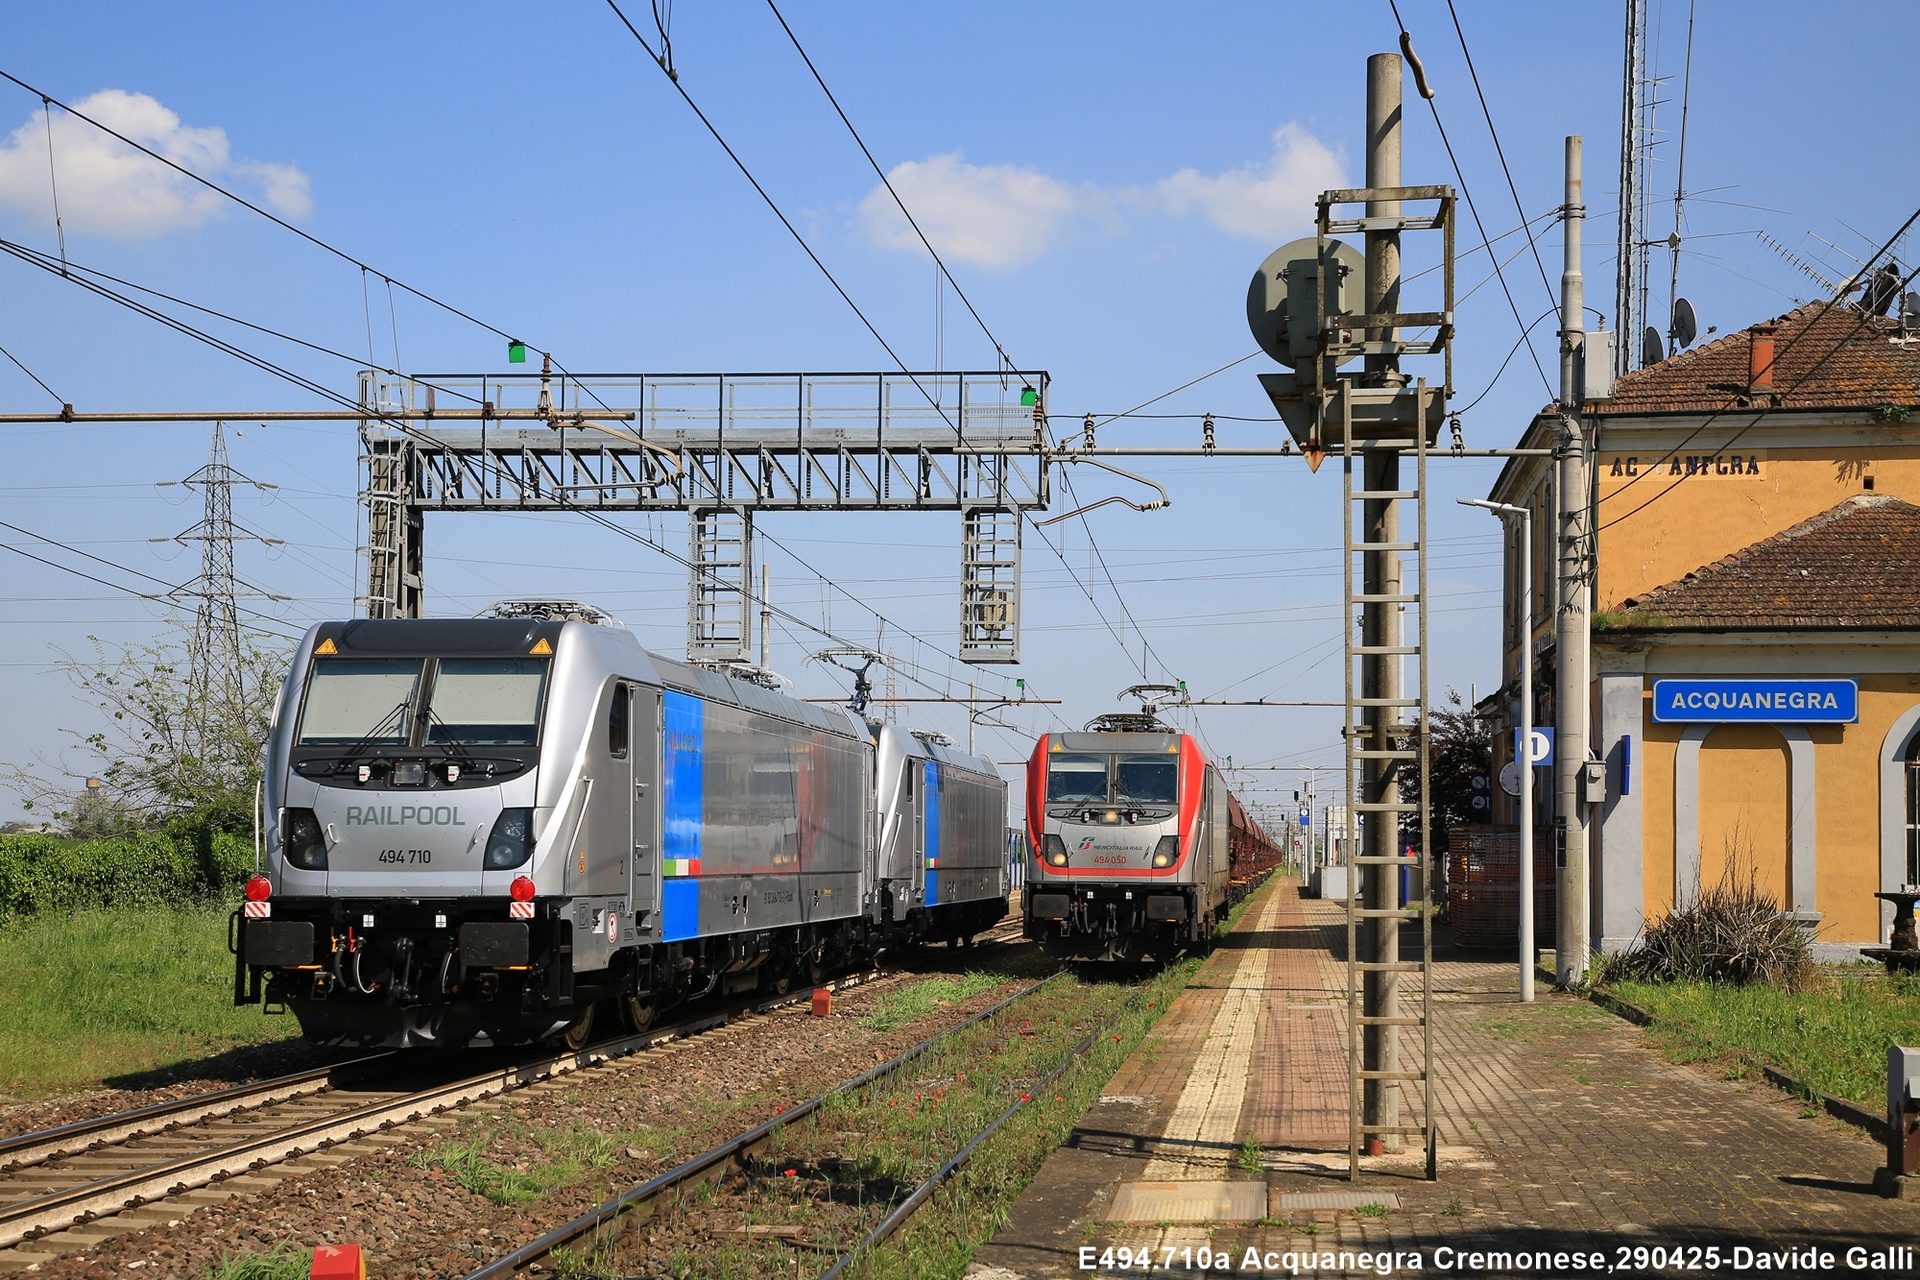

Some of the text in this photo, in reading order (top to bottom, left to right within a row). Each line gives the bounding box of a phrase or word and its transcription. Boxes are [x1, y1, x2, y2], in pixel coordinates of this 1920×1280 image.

[1671, 691, 1838, 710] ACQUANEGRA
[346, 806, 466, 826] RAILPOOL
[378, 849, 431, 864] 494 710
[1094, 855, 1127, 864] 494 050
